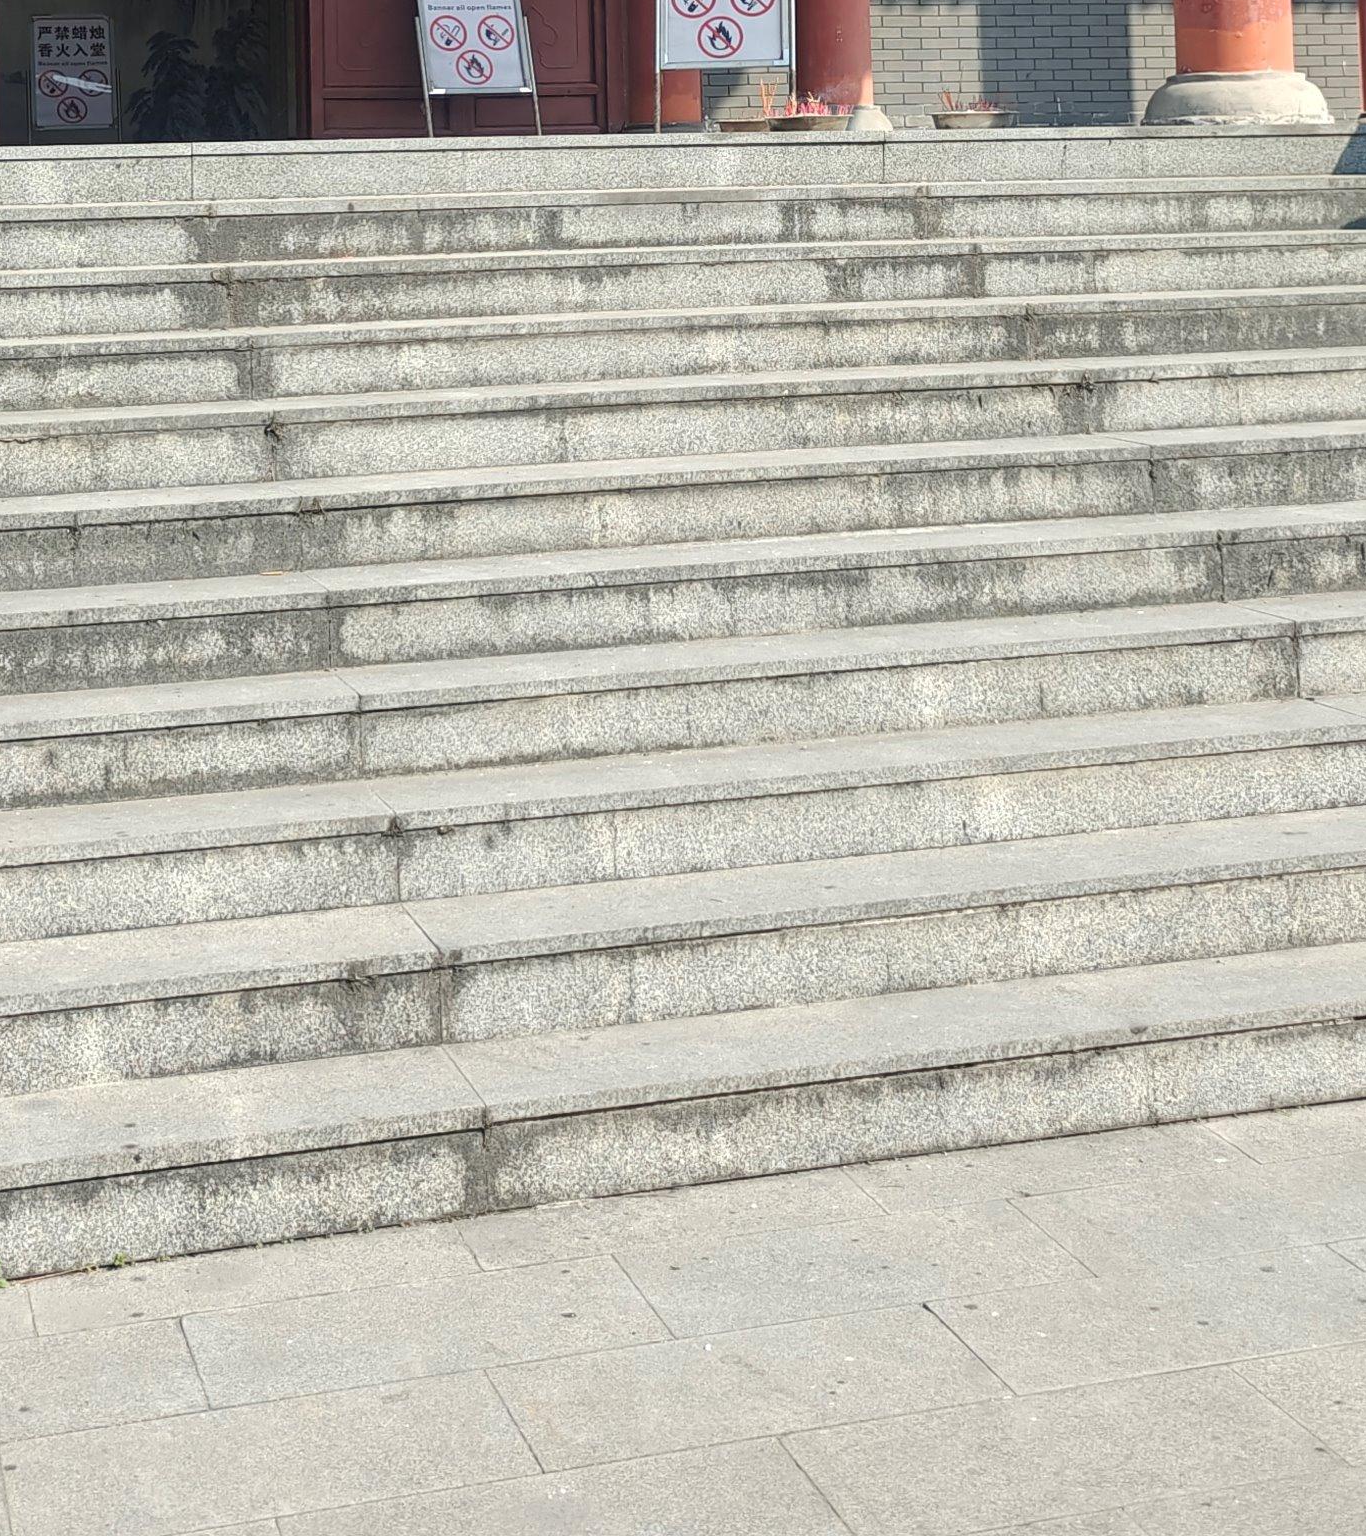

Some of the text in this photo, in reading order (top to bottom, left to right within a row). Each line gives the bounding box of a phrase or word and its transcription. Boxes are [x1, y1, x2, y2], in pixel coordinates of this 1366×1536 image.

[38, 25, 105, 40] 严禁蜡烛
[38, 43, 106, 57] 香火入堂
